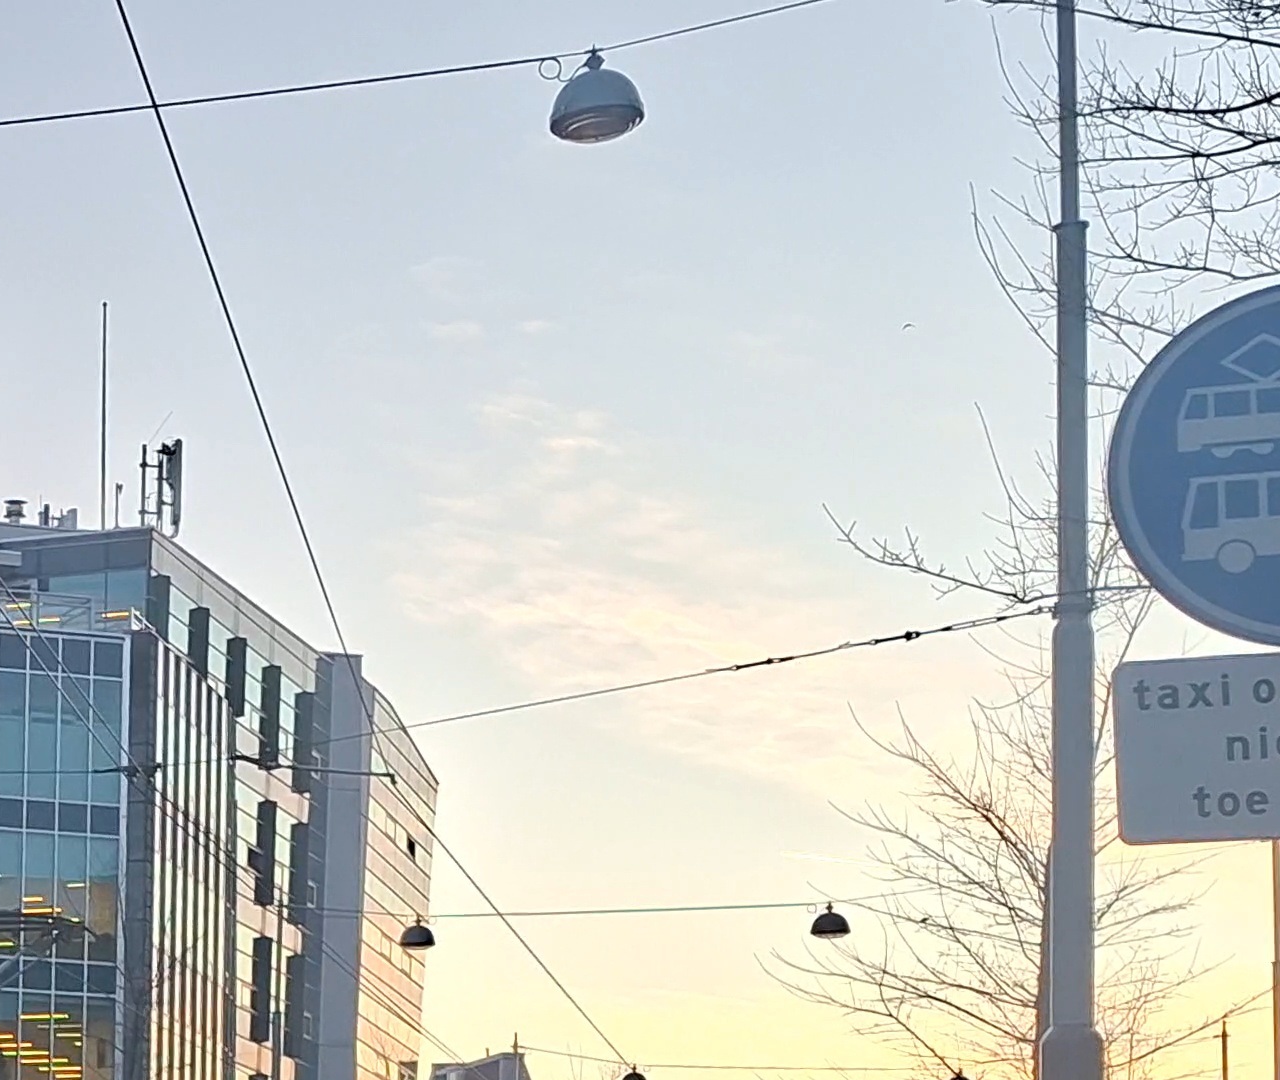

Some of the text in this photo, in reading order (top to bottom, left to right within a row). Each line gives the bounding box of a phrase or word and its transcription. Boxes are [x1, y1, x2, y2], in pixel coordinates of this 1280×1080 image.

[1132, 673, 1231, 711] taxi
[1225, 726, 1280, 762] ni
[1192, 786, 1270, 818] toe
